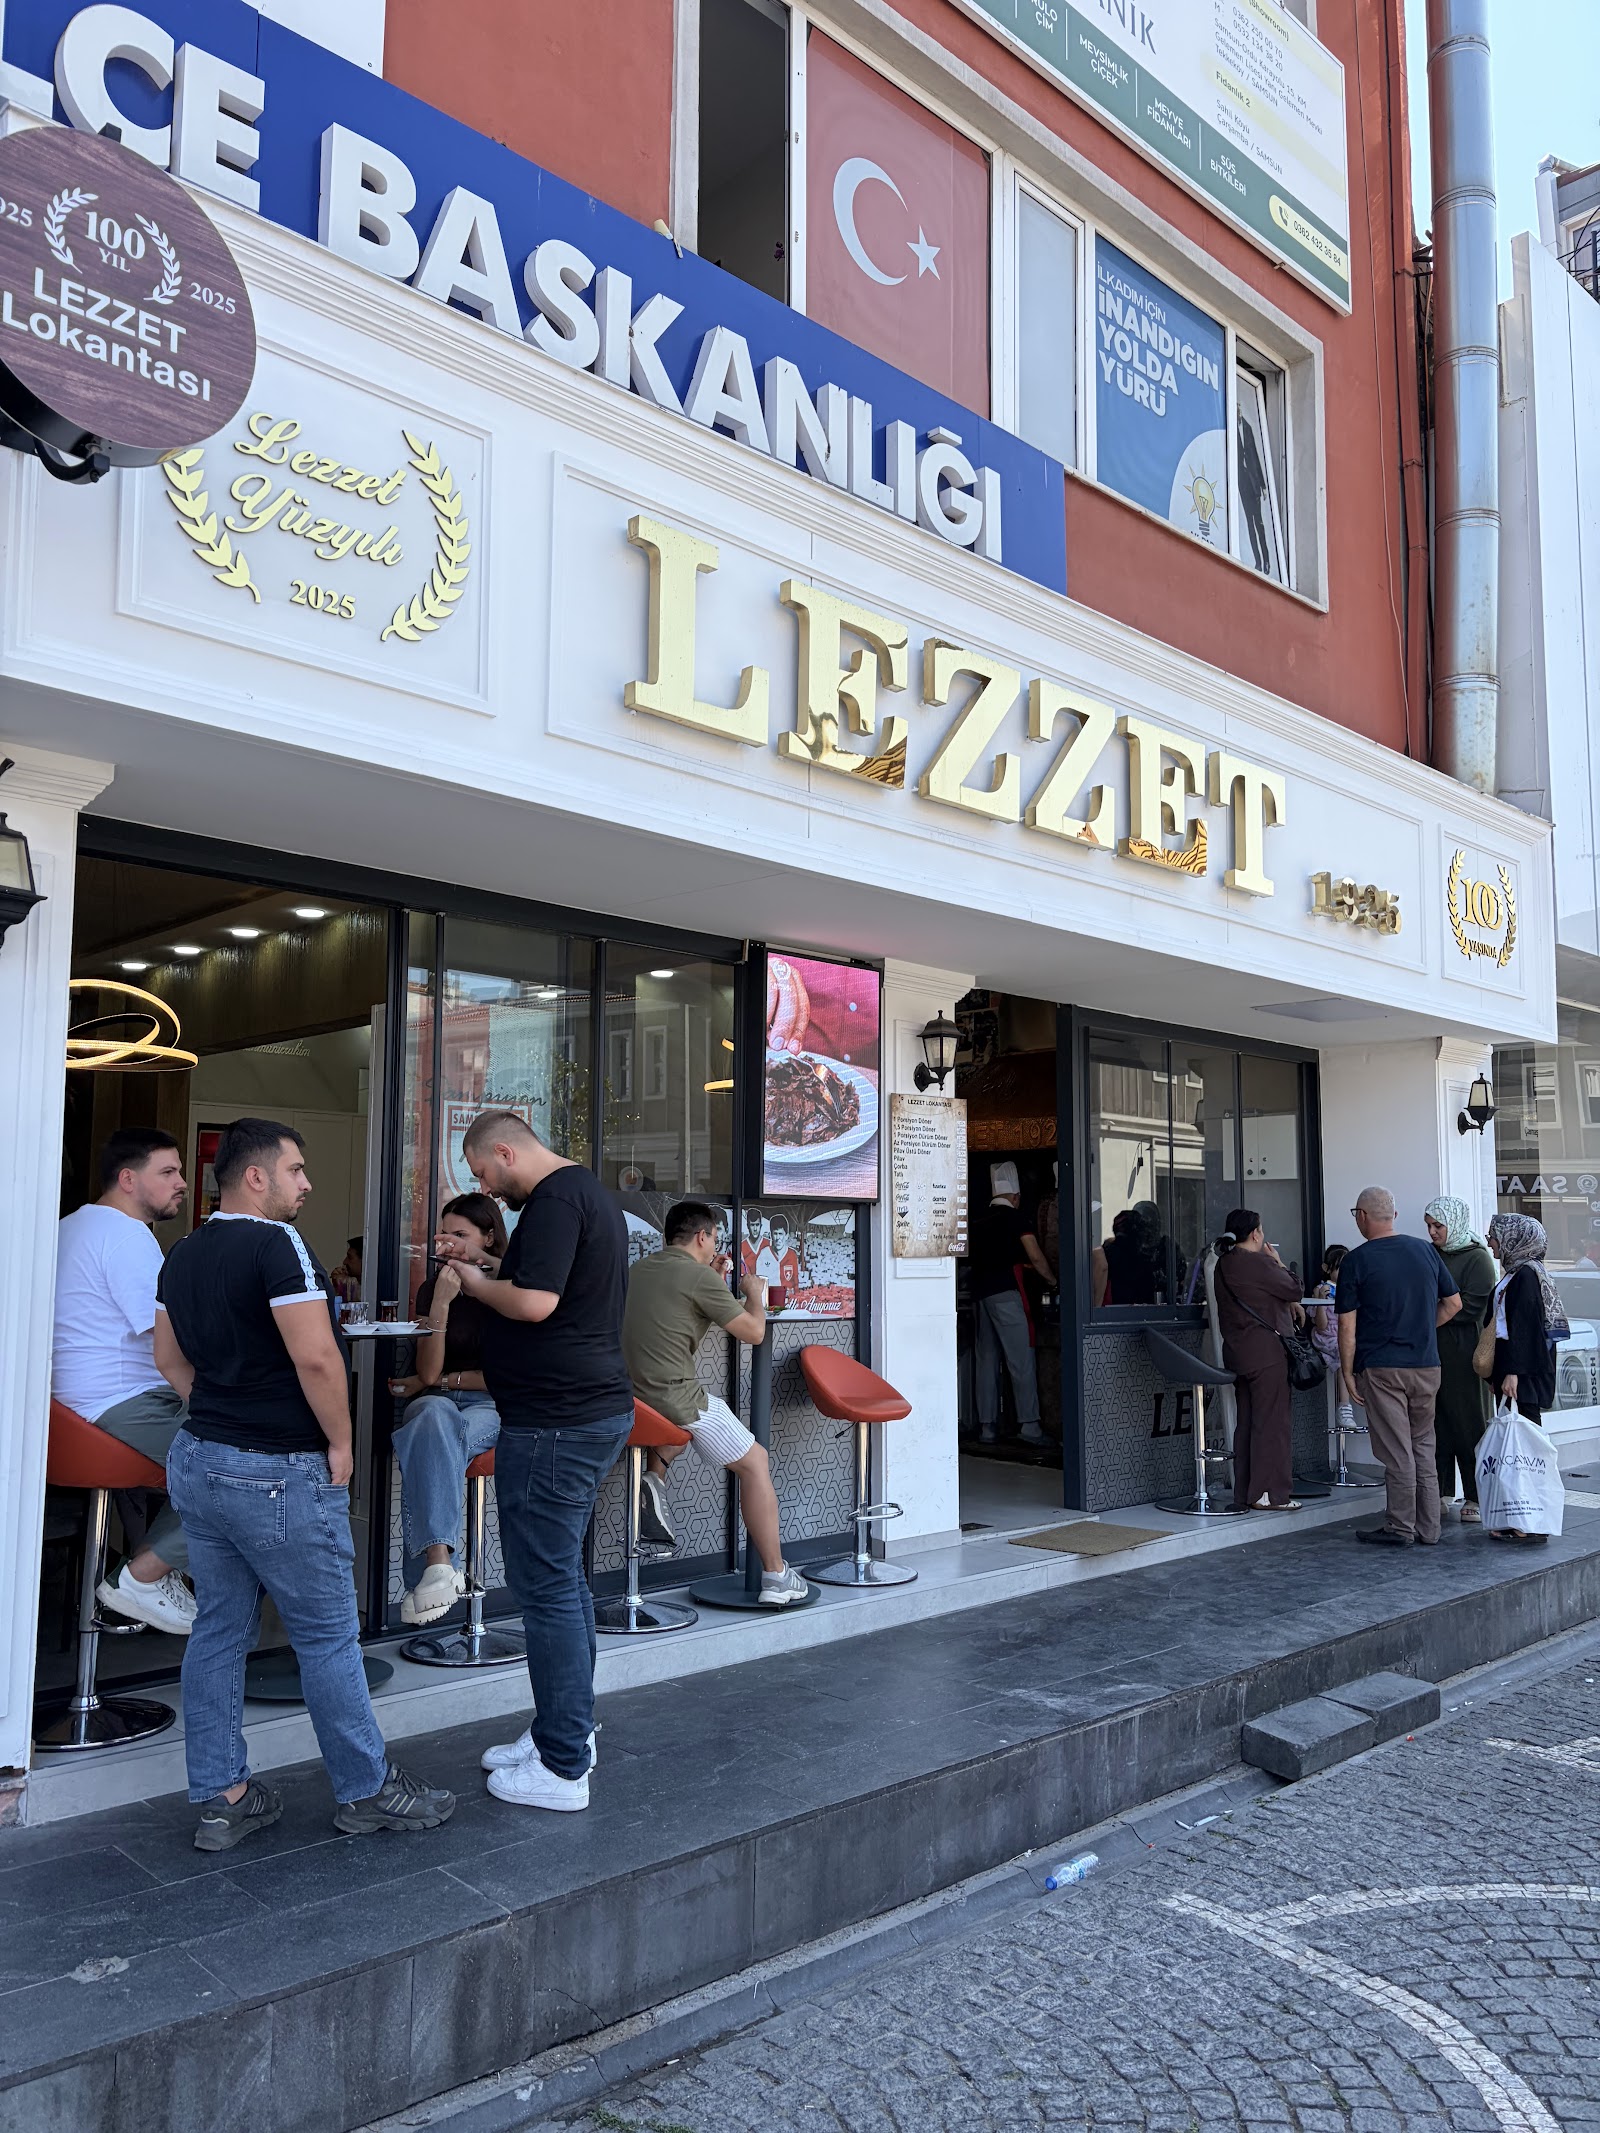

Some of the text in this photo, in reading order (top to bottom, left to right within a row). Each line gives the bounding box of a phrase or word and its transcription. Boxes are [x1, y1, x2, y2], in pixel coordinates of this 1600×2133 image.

[1035, 11, 1054, 34] ÇİM
[1099, 0, 1157, 55] NİK
[1233, 6, 1249, 27] 0362
[1079, 33, 1129, 84] MEVSİMLİK
[1091, 59, 1118, 89] ÇİÇEK
[1216, 70, 1251, 108] Fidanlık 2
[1216, 99, 1233, 117] Sahil
[1251, 77, 1278, 107] SAMSUN
[1147, 105, 1192, 150] FİDANLARI
[1154, 97, 1184, 131] MEYVE
[1210, 158, 1247, 196] BİTKİLERİ
[1220, 154, 1237, 175] SÜS
[1256, 146, 1283, 175] SAMSUN
[85, 211, 146, 260] 100
[1293, 220, 1310, 240] 0362
[99, 247, 131, 273] YIL
[34, 266, 187, 354] LEZZET
[190, 282, 237, 315] 2025
[1097, 261, 1166, 325] İLKADIM İÇİN
[2, 290, 211, 402] Lokantası
[1098, 288, 1219, 391] İNANDIĞIN
[1098, 317, 1180, 396] YOLDA
[1098, 350, 1167, 417] YÜRÜ
[234, 412, 407, 505] Lezzet
[290, 579, 356, 619] 2025
[624, 514, 1287, 898] LEZZET
[1460, 877, 1503, 931] 100
[1589, 1356, 1598, 1406] BOSCH
